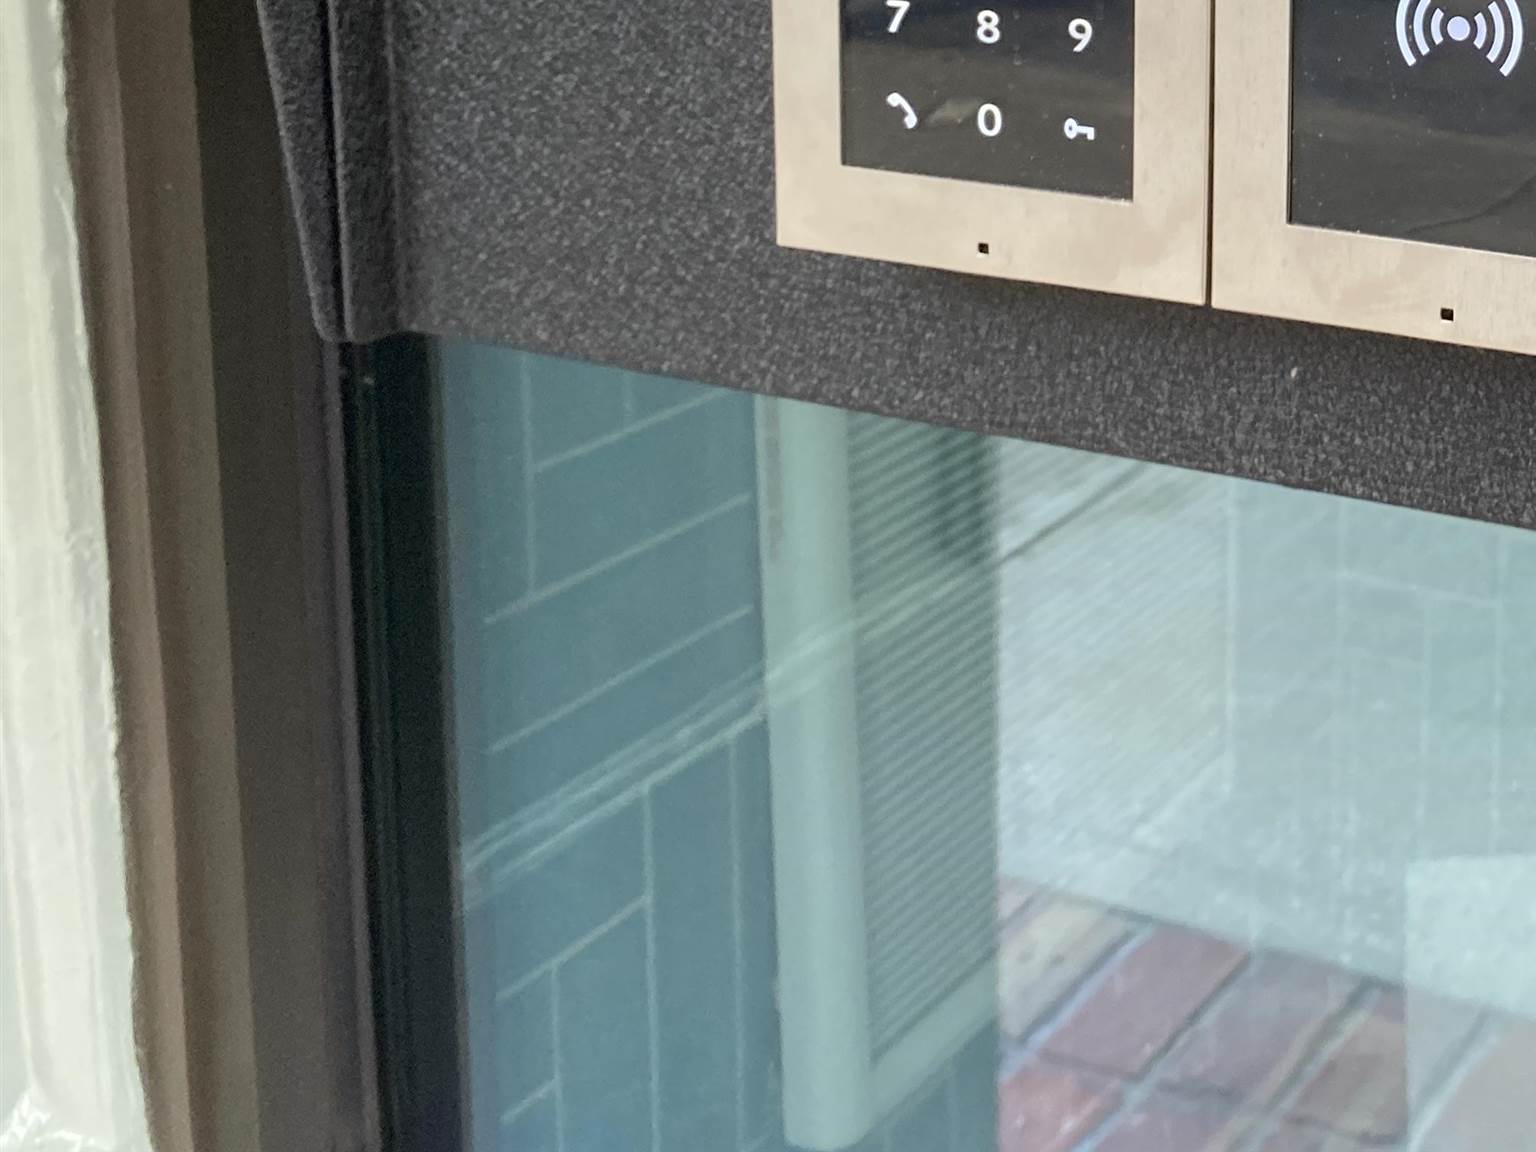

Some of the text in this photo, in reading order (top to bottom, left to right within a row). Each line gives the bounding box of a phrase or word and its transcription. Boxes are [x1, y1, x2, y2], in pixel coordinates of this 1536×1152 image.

[886, 0, 1093, 53] 7 8 9
